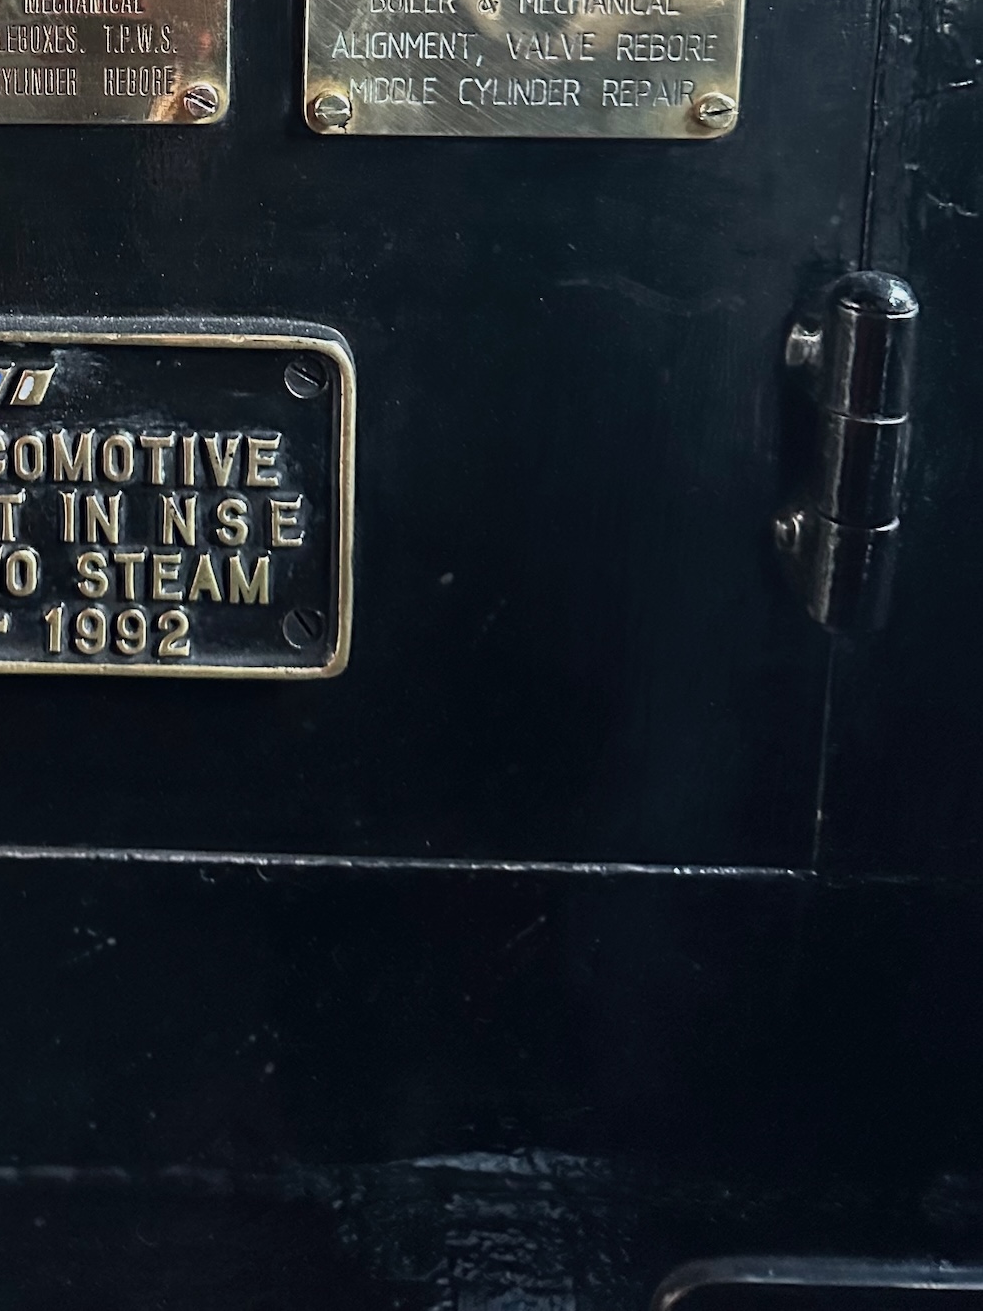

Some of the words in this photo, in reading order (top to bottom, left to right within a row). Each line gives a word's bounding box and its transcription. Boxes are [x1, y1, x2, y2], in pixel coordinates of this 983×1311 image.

[331, 31, 483, 67] ALIGNMENT,
[506, 32, 595, 62] VALVE
[617, 34, 717, 62] REBORE
[103, 67, 174, 97] REBORE
[459, 77, 579, 107] CYLINDER
[602, 79, 694, 108] REPAIR
[60, 490, 123, 545] IN
[77, 548, 273, 605] STEAM
[45, 602, 193, 658] 1992
